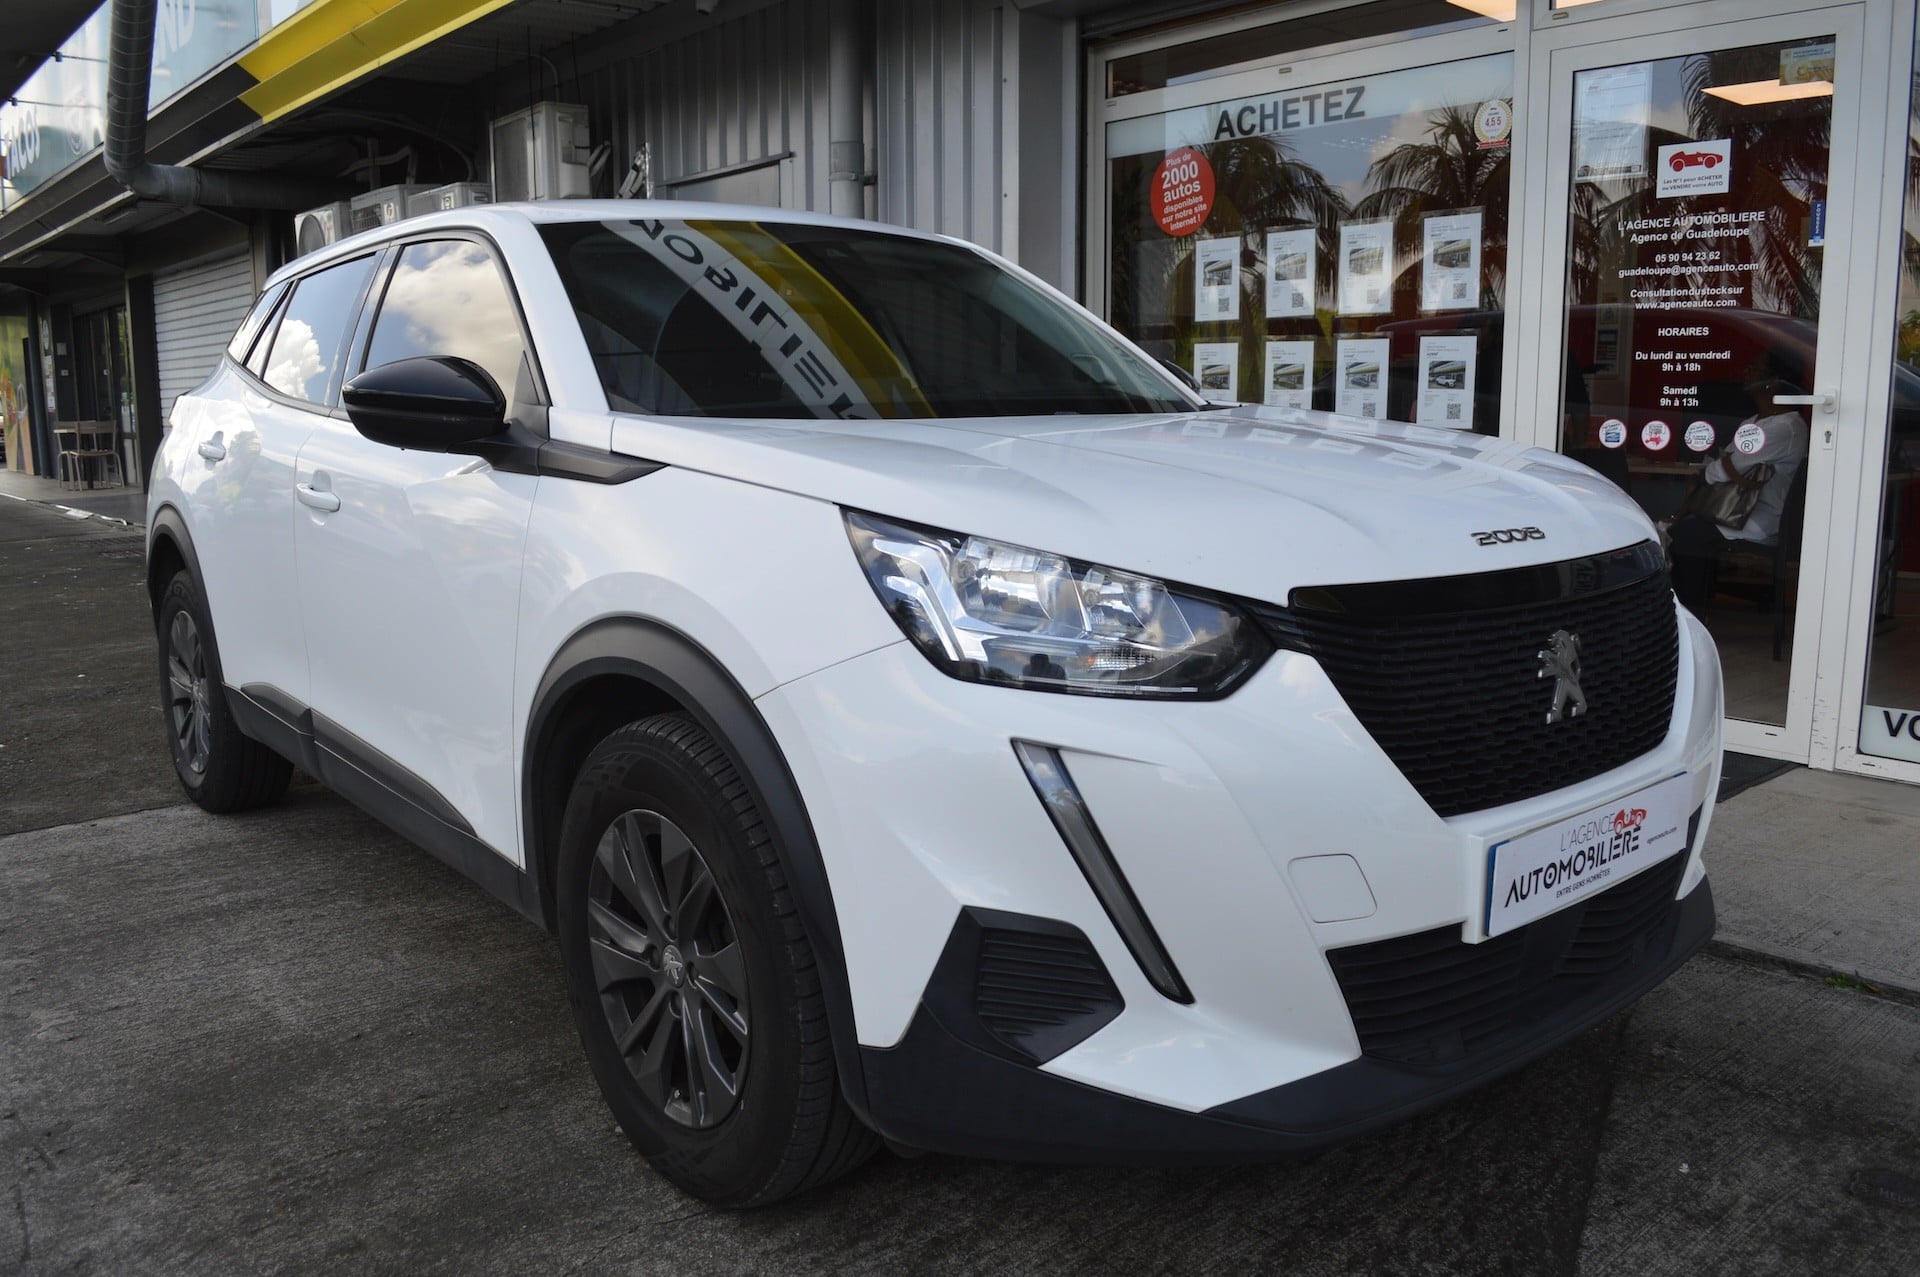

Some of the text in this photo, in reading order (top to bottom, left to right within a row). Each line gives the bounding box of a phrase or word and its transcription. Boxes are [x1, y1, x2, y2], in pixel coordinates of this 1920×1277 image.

[1214, 86, 1366, 140] ACHETEZ
[1165, 152, 1192, 168] Plus de
[1161, 161, 1199, 189] 2000
[1163, 180, 1201, 203] autos
[1163, 194, 1204, 214] disponibles
[1162, 203, 1207, 224] sur notre site
[1618, 211, 1765, 231] L'AGENCE AUTOMOBILIERE
[1630, 226, 1750, 244] Agence de Guadeloupe
[1655, 251, 1721, 263] 05 90 94 23 62
[1618, 262, 1759, 278] guadeloupe@agenceauto.com
[1635, 298, 1737, 310] www.agenceauto.com
[1657, 327, 1710, 336] HORAIRES
[1635, 350, 1731, 360] Du lundi au vendredi
[1662, 362, 1701, 372] 9h à 18h
[1663, 386, 1698, 395] Samedi
[1659, 397, 1699, 406] 9h à 13h
[1471, 526, 1546, 546] 2008
[1560, 813, 1615, 852] L'AGENCE
[1556, 885, 1572, 898] ENTRE
[1572, 879, 1585, 891] GENS
